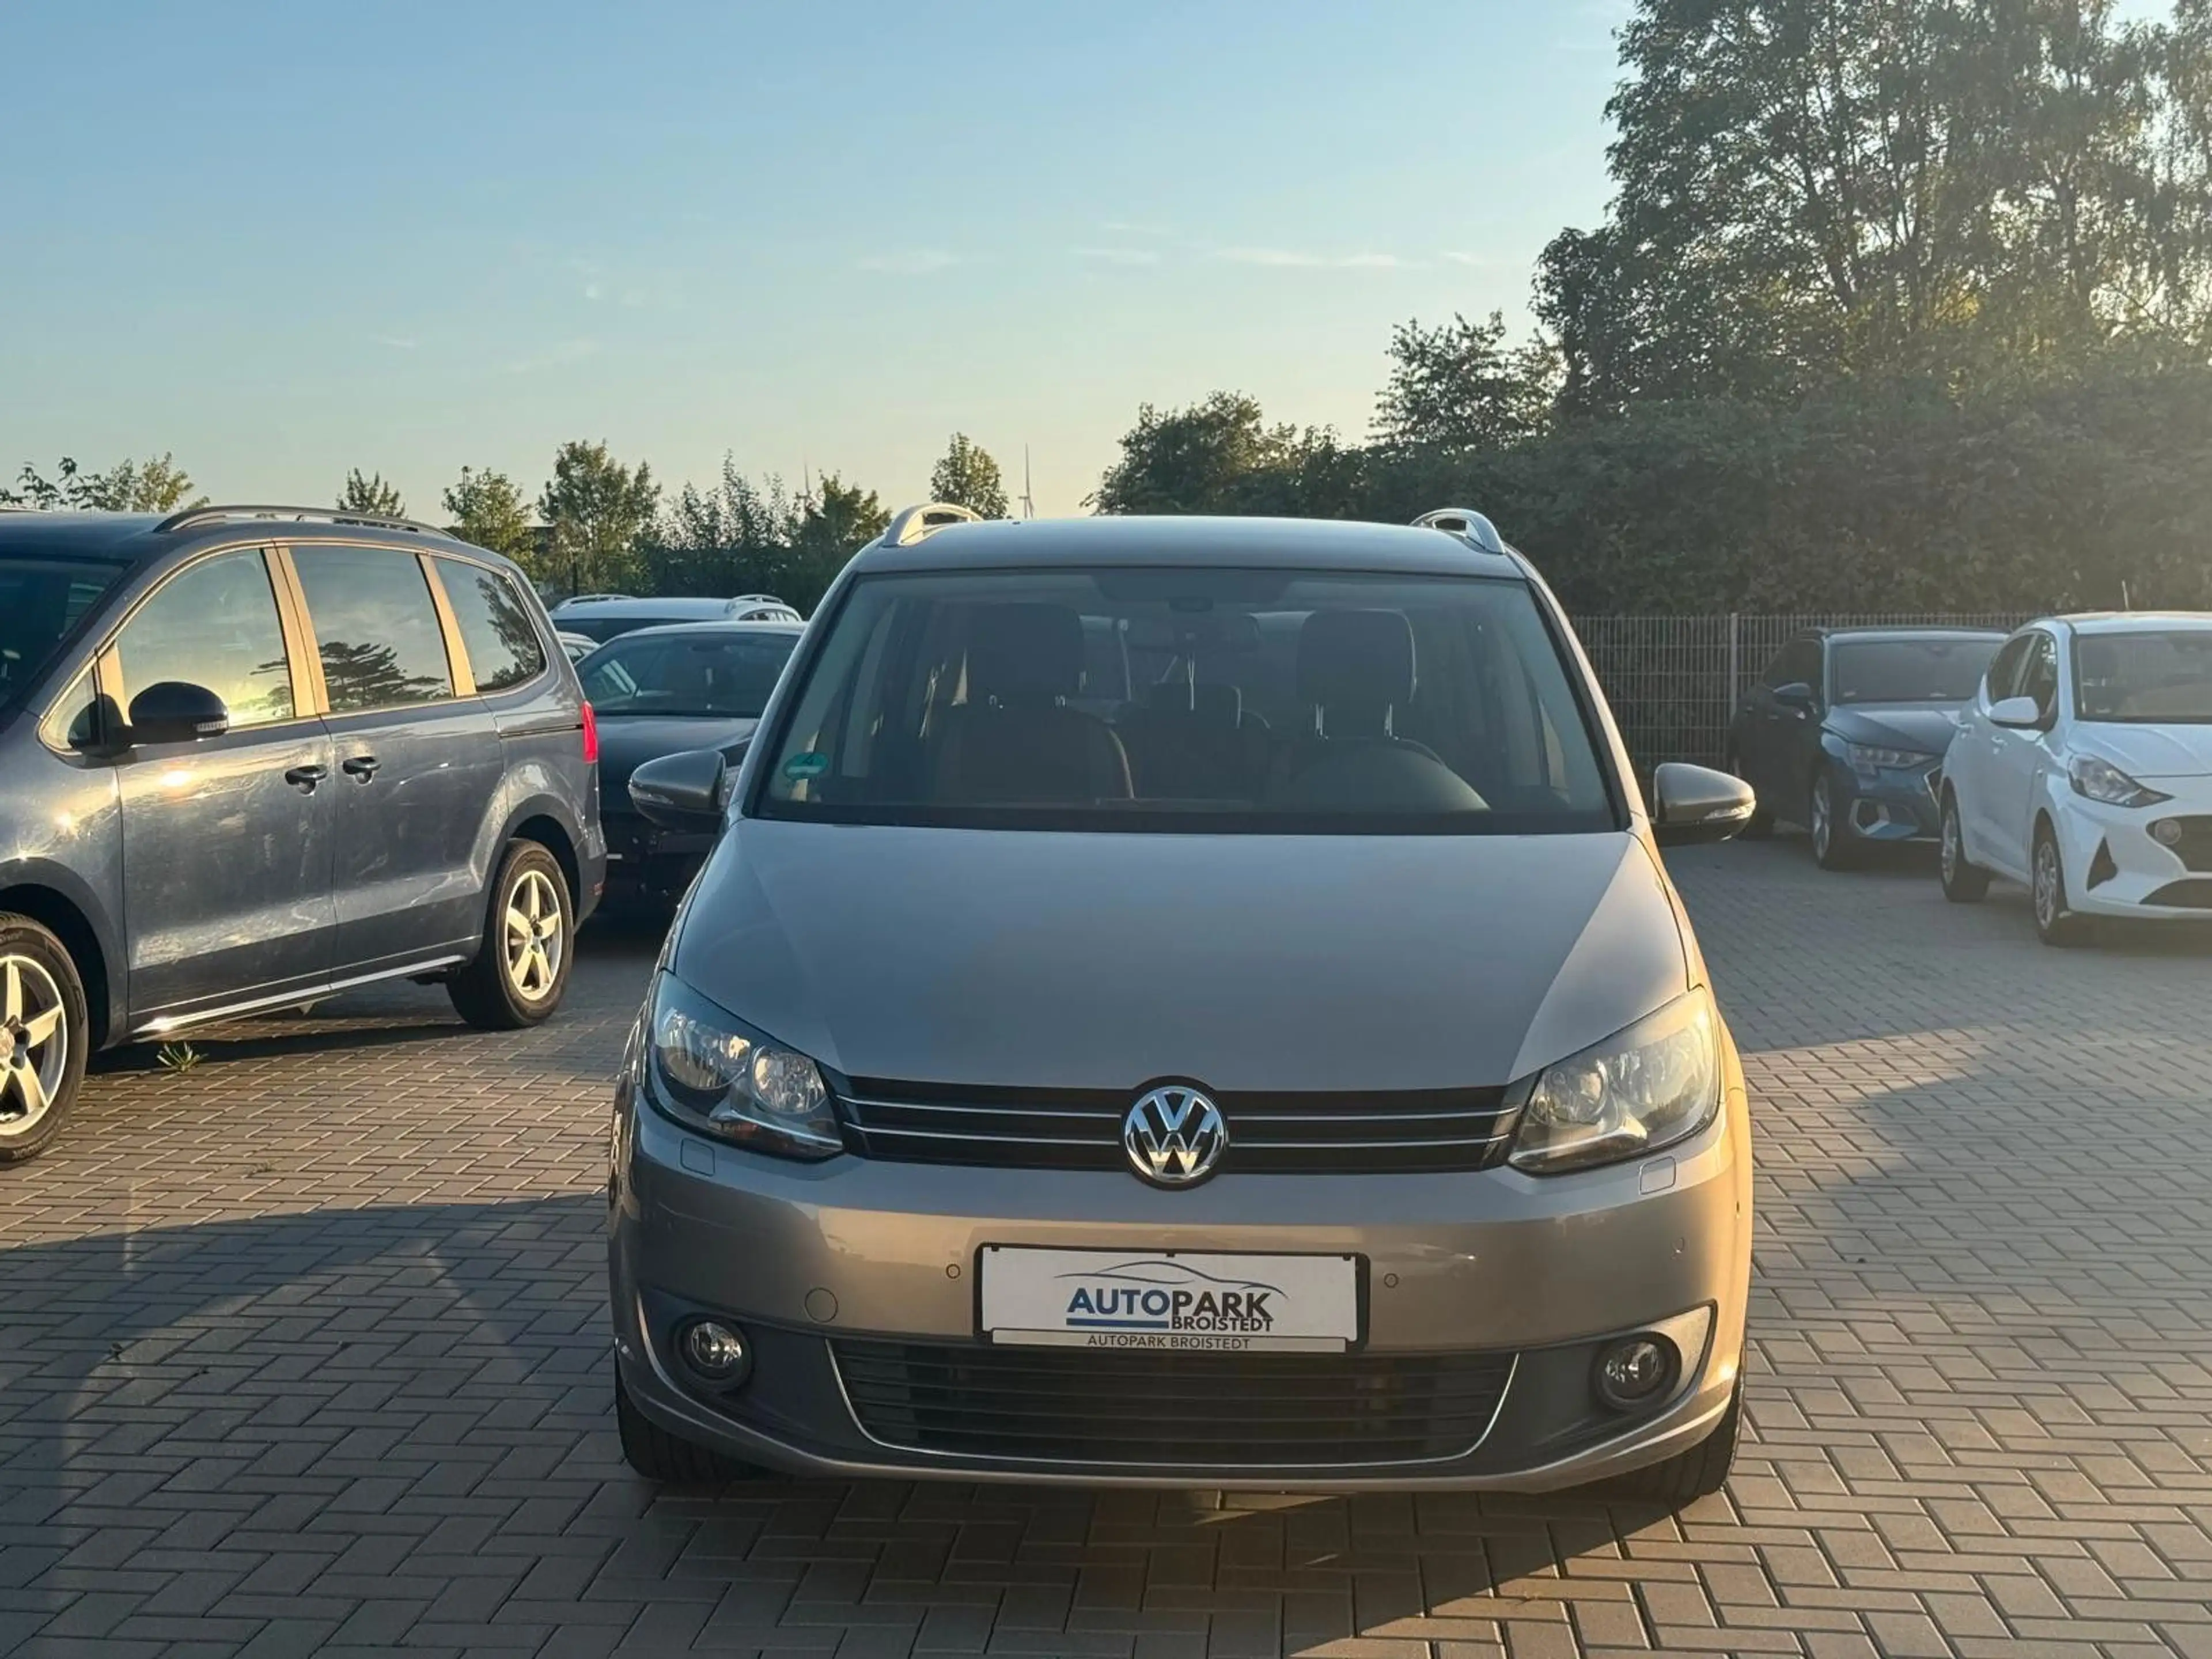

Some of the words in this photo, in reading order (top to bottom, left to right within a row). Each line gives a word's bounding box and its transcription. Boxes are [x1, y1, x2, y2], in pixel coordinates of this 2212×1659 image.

[1127, 1087, 1223, 1180] VW
[1067, 1287, 1273, 1320] AUTOPARK
[1171, 1316, 1272, 1332] BROISTEDT
[1088, 1335, 1166, 1347] AUTOPARK
[1171, 1336, 1251, 1349] BROISTEDT
